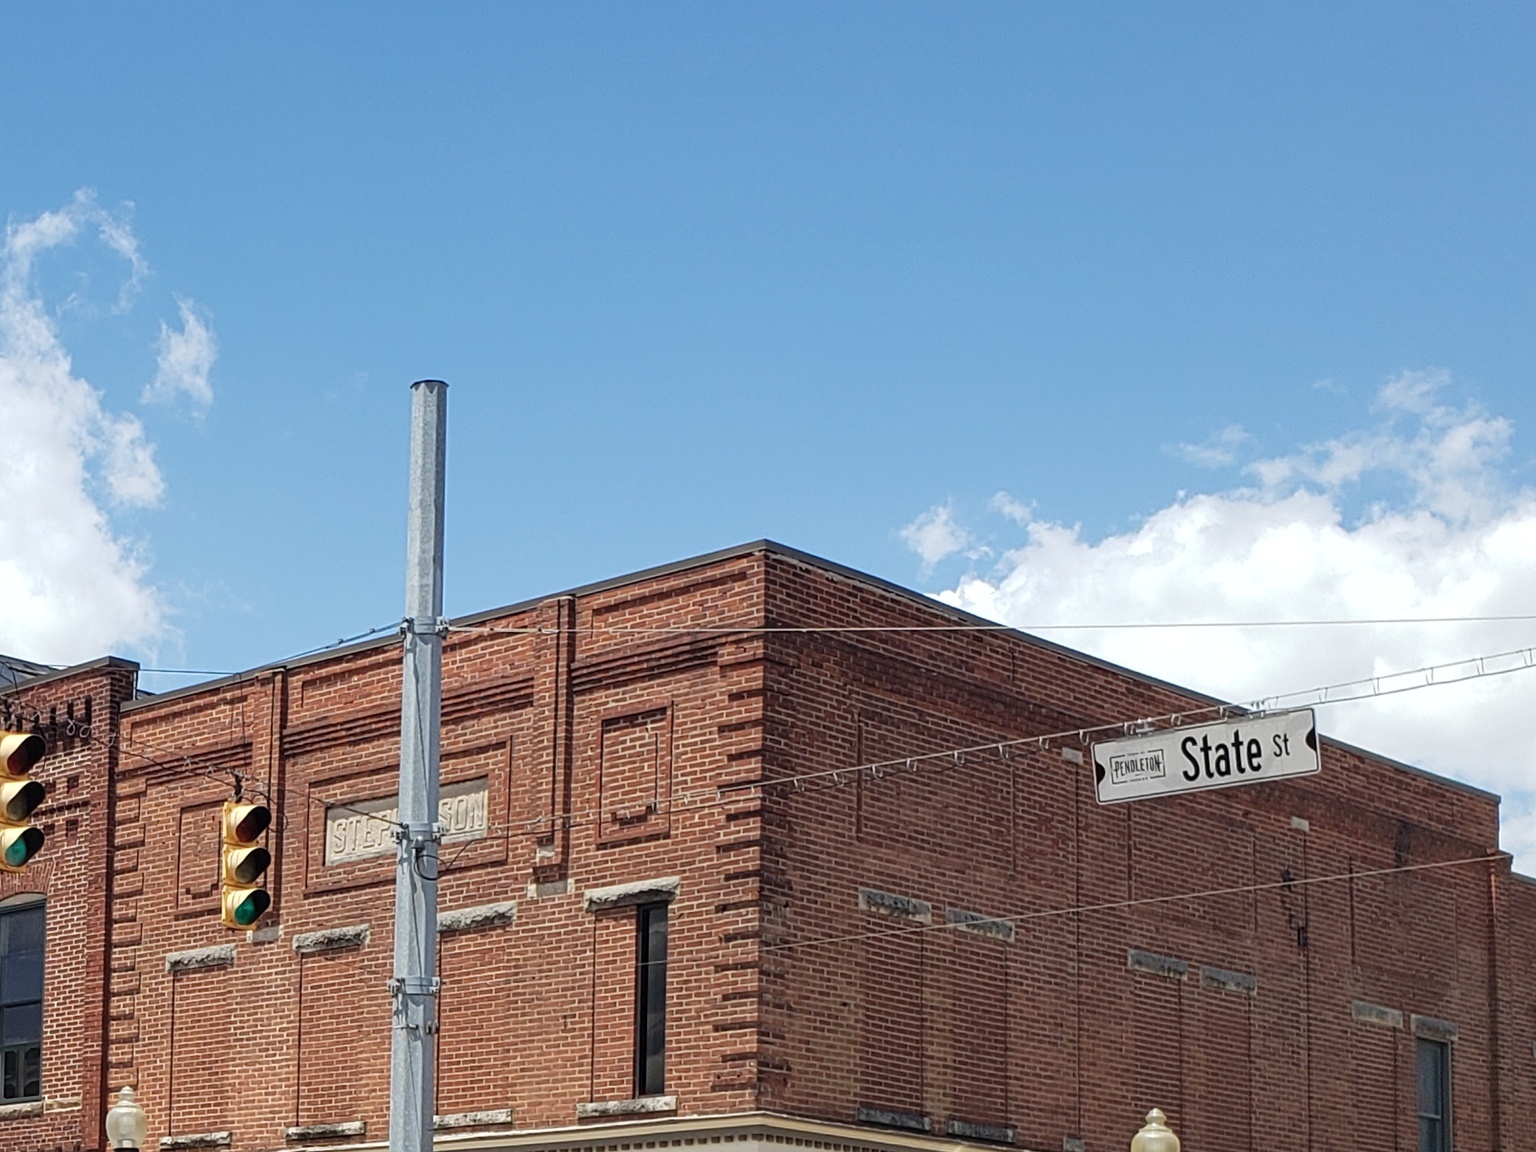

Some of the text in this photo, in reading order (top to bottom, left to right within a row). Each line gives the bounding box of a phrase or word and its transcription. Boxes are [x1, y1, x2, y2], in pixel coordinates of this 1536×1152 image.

[1113, 755, 1162, 778] PENDLETON
[1181, 729, 1291, 782] State St
[331, 791, 485, 854] STEPSON
